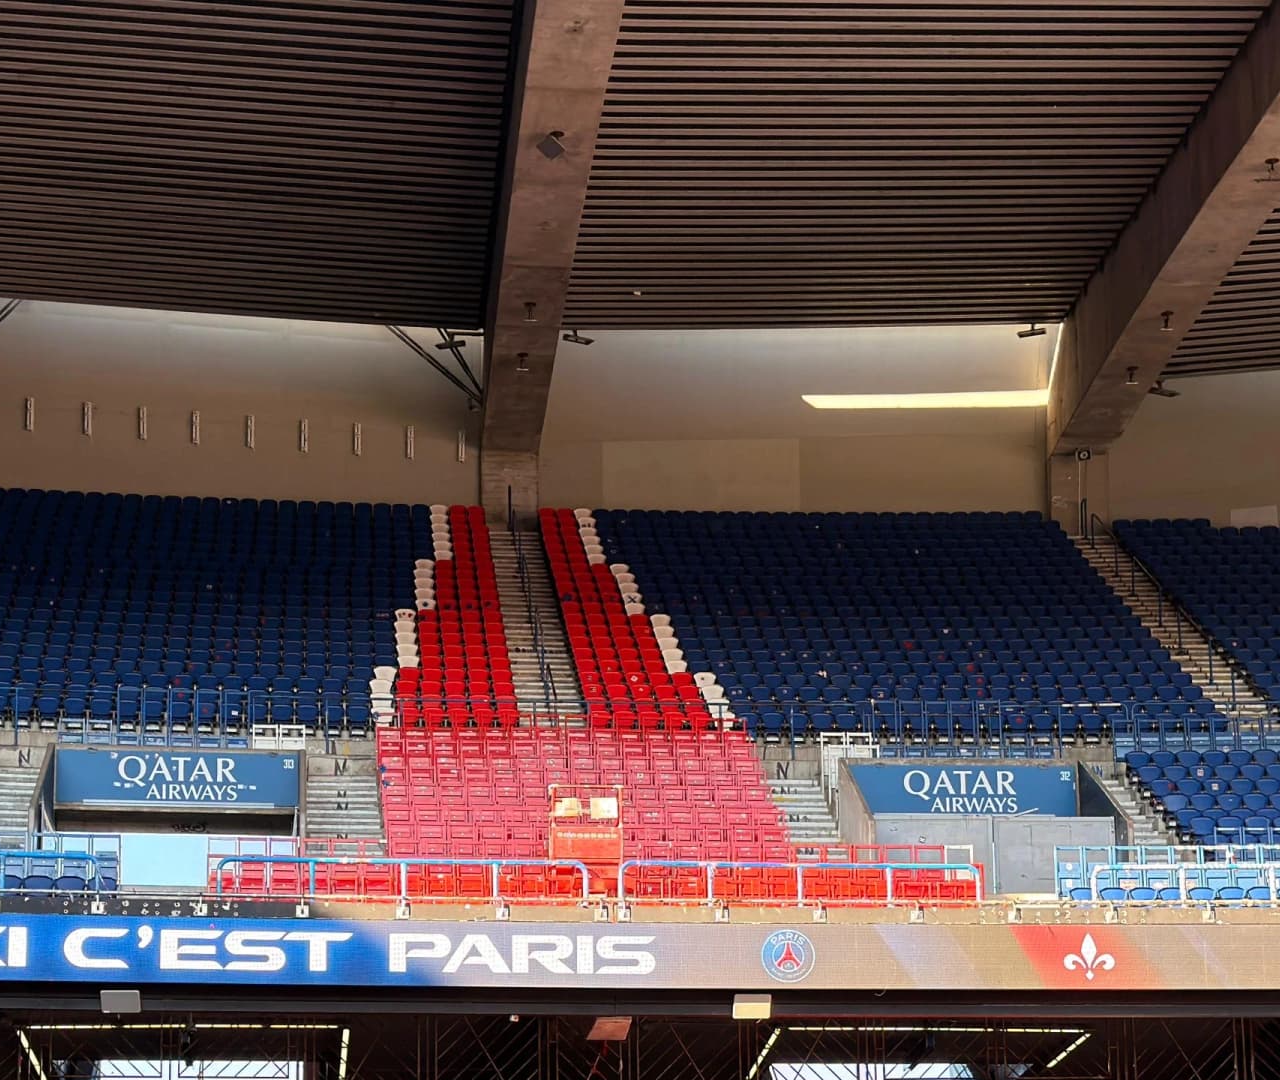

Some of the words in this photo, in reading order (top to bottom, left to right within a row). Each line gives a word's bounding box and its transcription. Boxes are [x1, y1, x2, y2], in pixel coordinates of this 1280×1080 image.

[118, 755, 238, 788] QATAR
[146, 784, 238, 801] AIRWAYS
[903, 770, 1017, 800] QATAR
[931, 797, 1018, 813] AIRWAYS
[63, 925, 354, 972] C'EST
[388, 933, 657, 975] PARIS
[770, 932, 806, 945] PARIS
